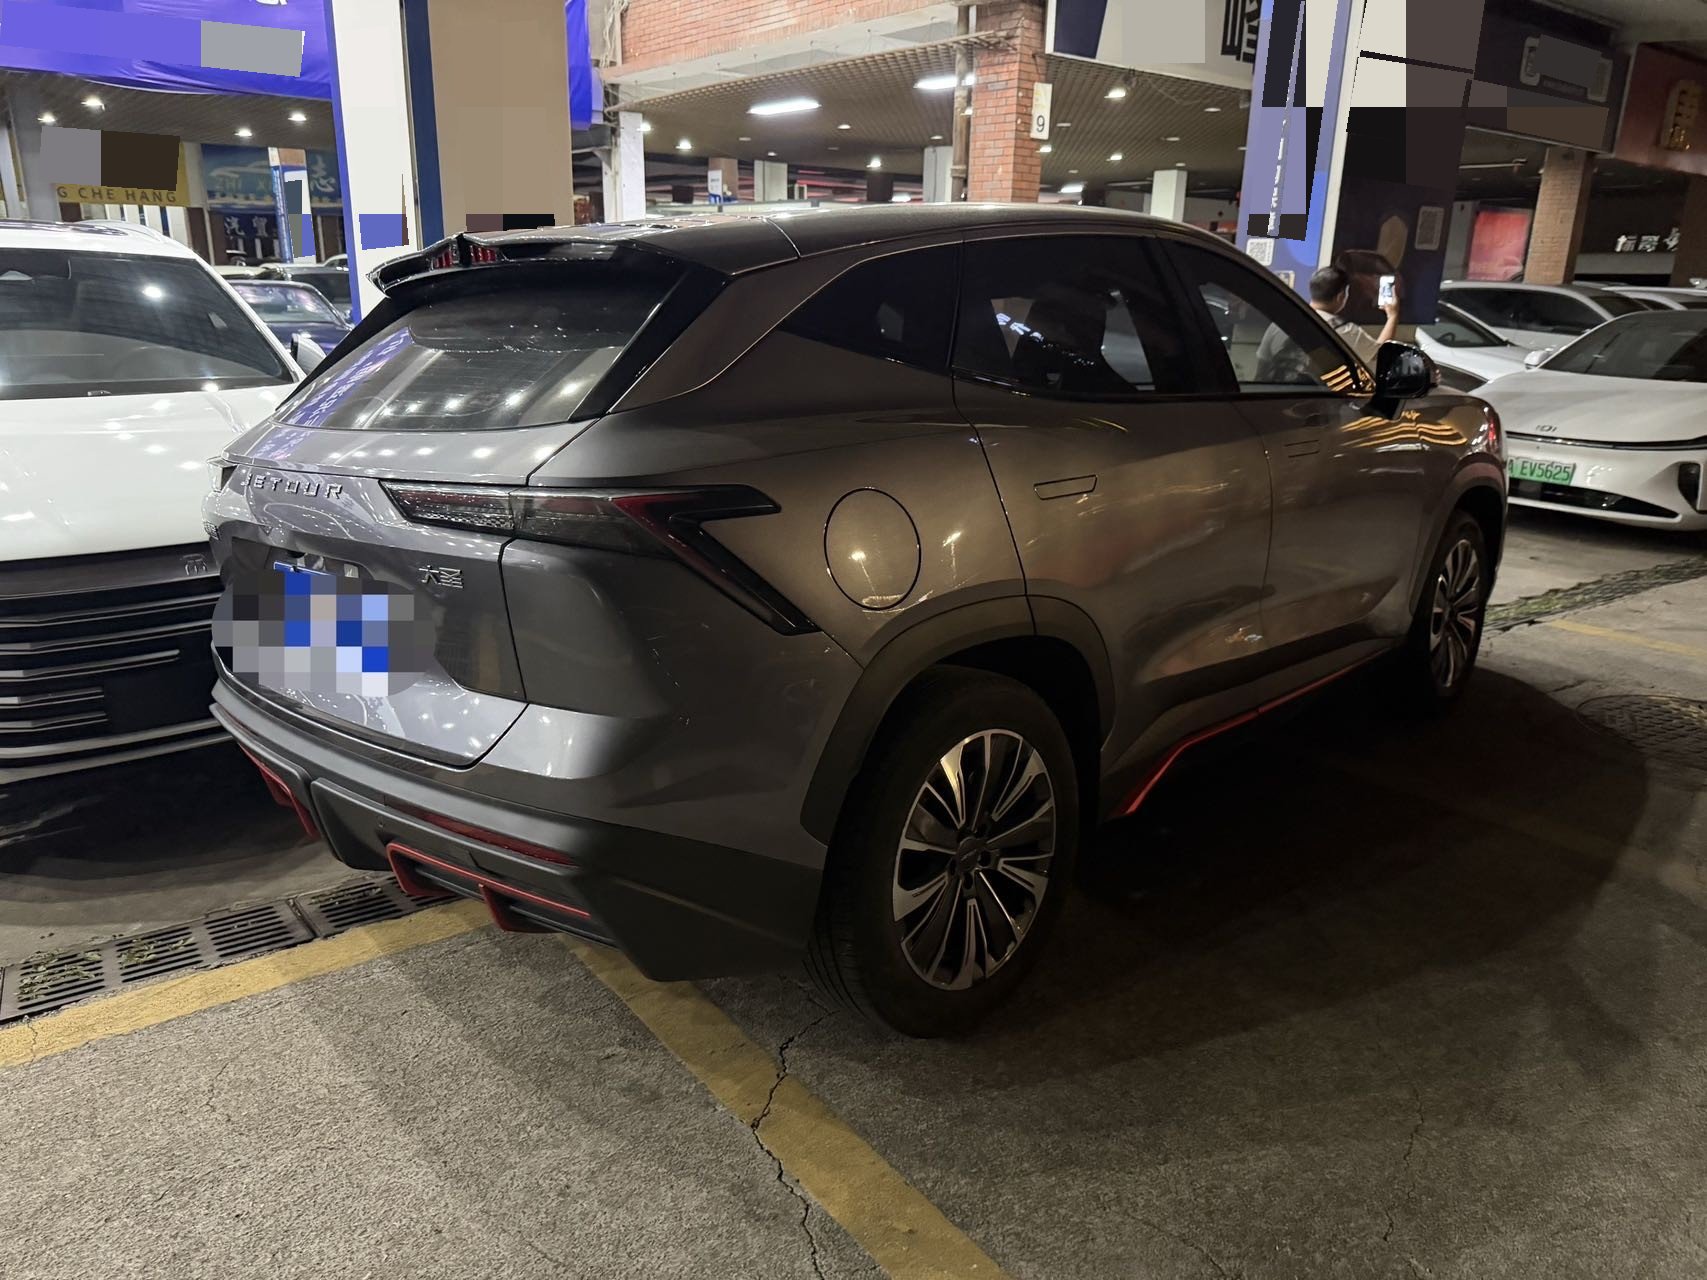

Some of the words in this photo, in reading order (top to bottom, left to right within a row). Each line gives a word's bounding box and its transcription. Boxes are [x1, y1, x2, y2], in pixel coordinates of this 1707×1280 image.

[1036, 114, 1045, 133] 9
[310, 153, 336, 193] 志
[78, 187, 115, 200] CHE
[125, 190, 177, 203] HANG
[1520, 460, 1571, 482] EV5625
[241, 473, 343, 499] JETOUR
